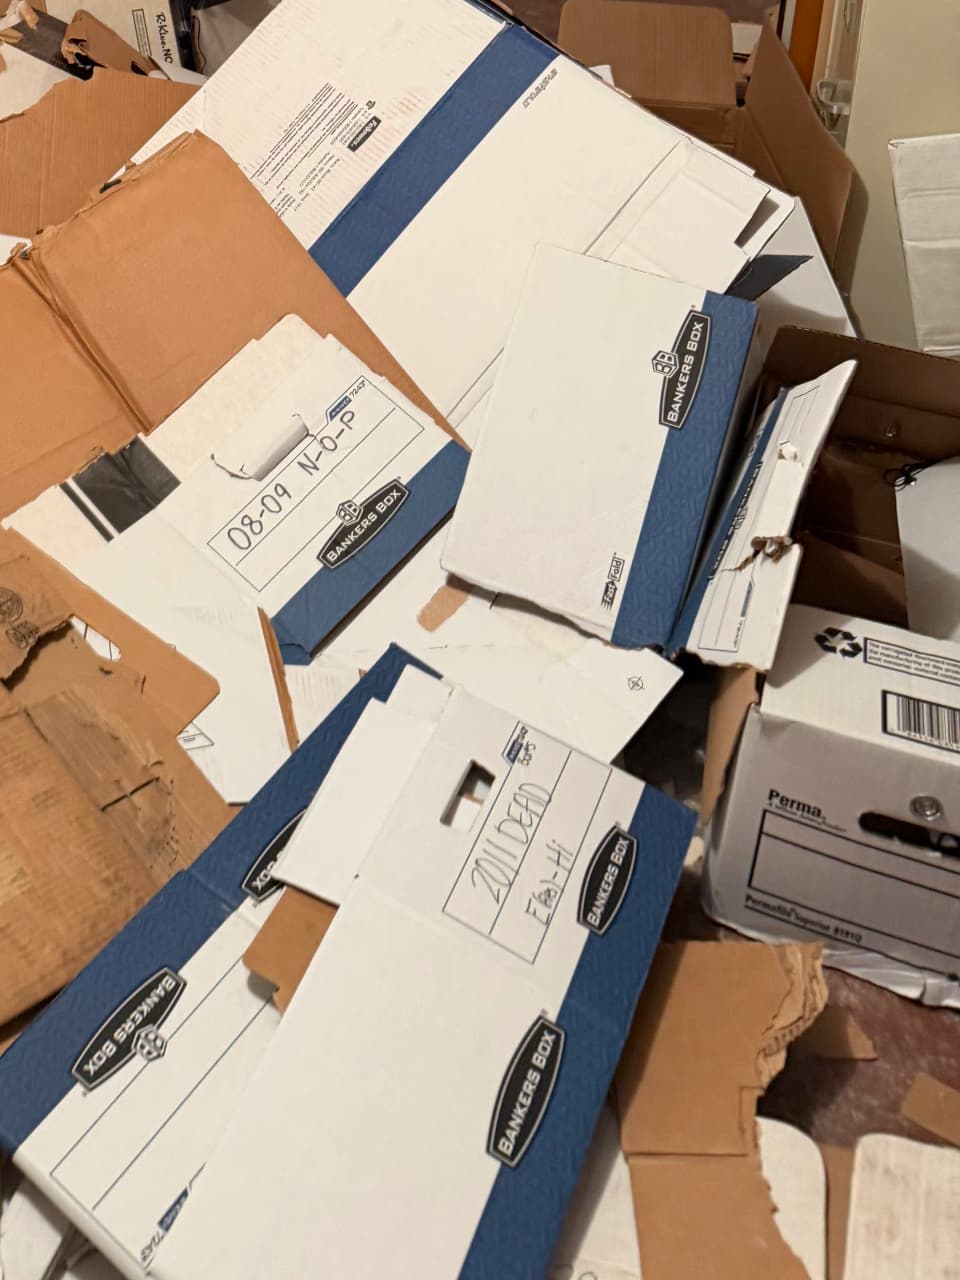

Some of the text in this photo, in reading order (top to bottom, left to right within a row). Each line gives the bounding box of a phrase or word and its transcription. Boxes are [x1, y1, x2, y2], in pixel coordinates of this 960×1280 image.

[667, 321, 704, 422] BANKERS BOX
[227, 410, 355, 551] 08-09 N-O-P
[326, 489, 401, 563] BANKERS BOX
[610, 559, 623, 580] Fold
[497, 782, 553, 845] DEAD
[767, 788, 823, 819] Perma
[587, 836, 631, 927] BANKERS BOX
[83, 975, 177, 1077] BANKERS BOX
[497, 1029, 557, 1157] BANKERS BOX
